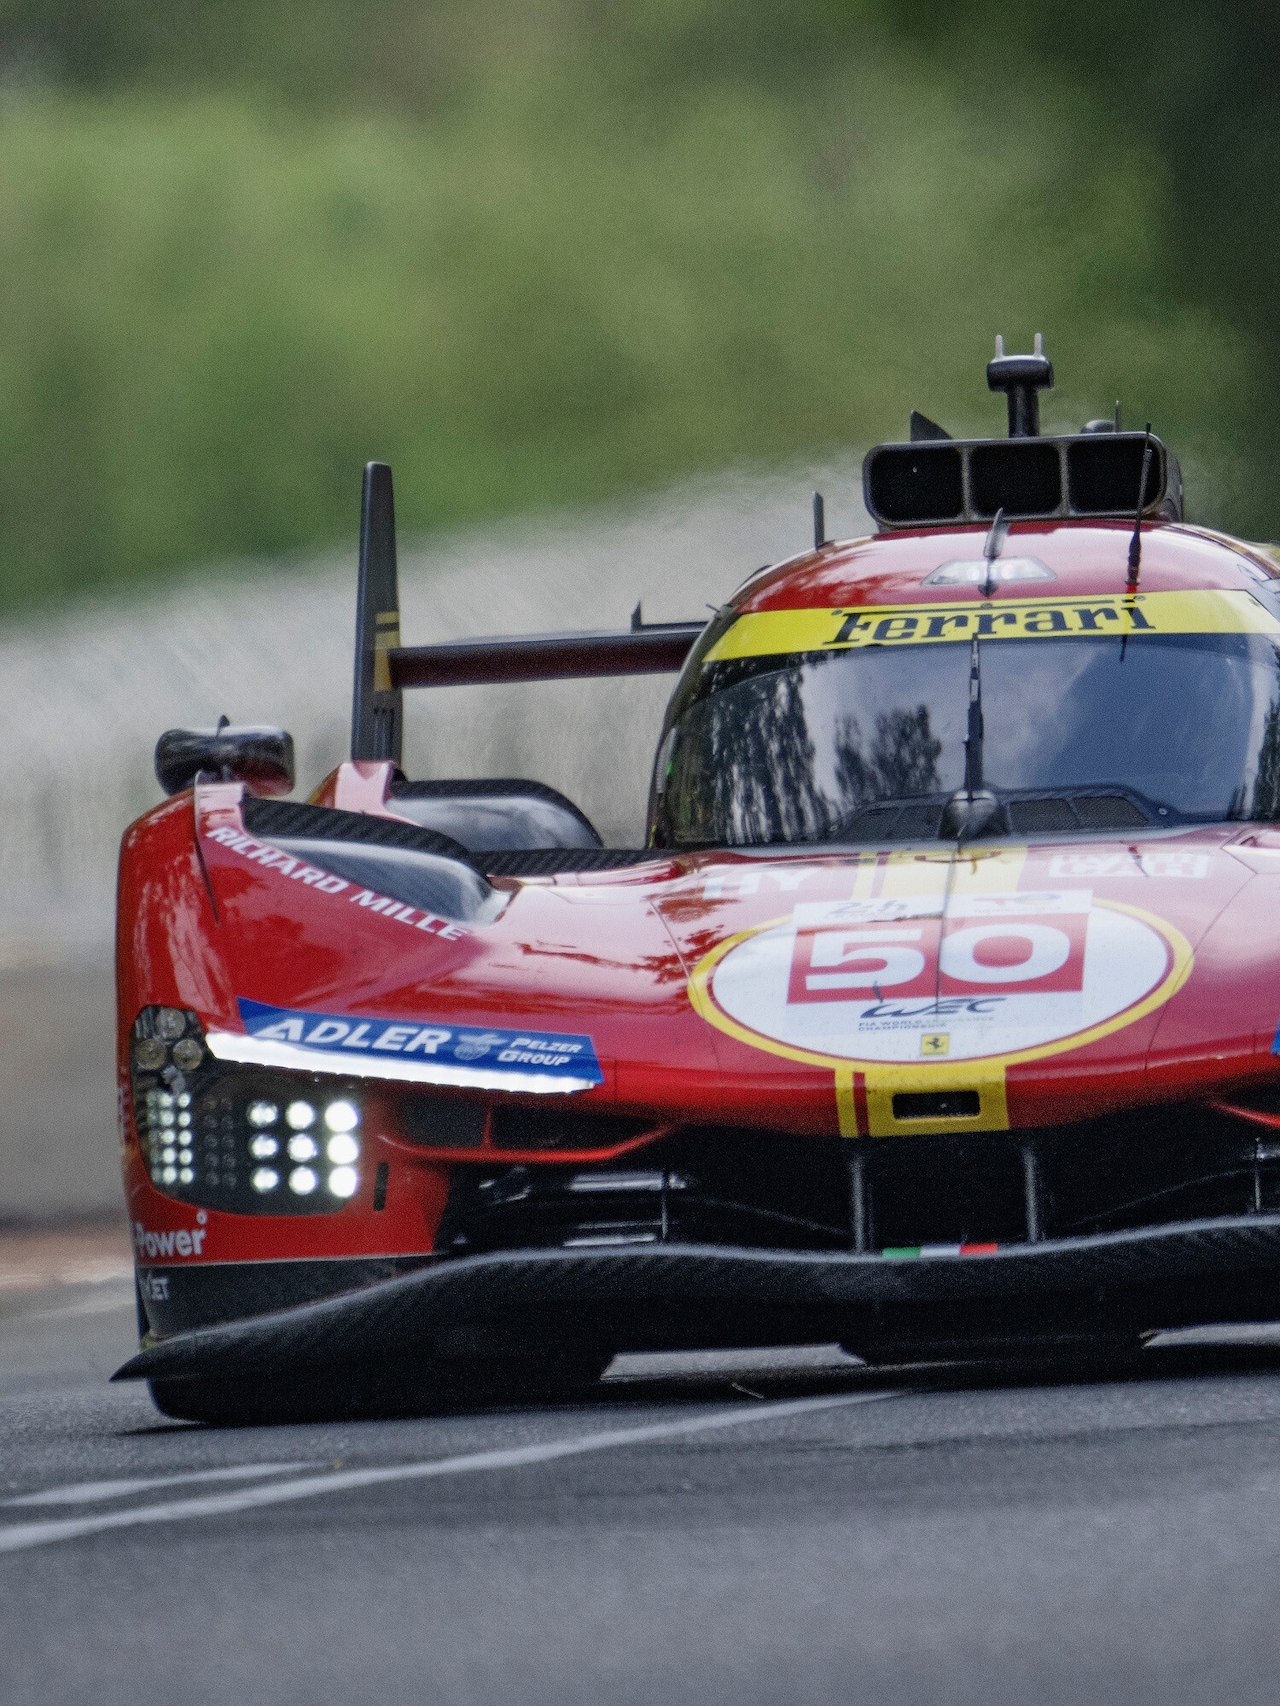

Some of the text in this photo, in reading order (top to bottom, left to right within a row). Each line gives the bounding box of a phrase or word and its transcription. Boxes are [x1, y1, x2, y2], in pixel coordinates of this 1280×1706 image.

[822, 599, 1156, 645] Ferrari
[206, 825, 470, 941] RICHARD MILLE
[804, 922, 1071, 991] 50
[860, 998, 1007, 1018] WEC
[251, 1018, 452, 1054] ADLER
